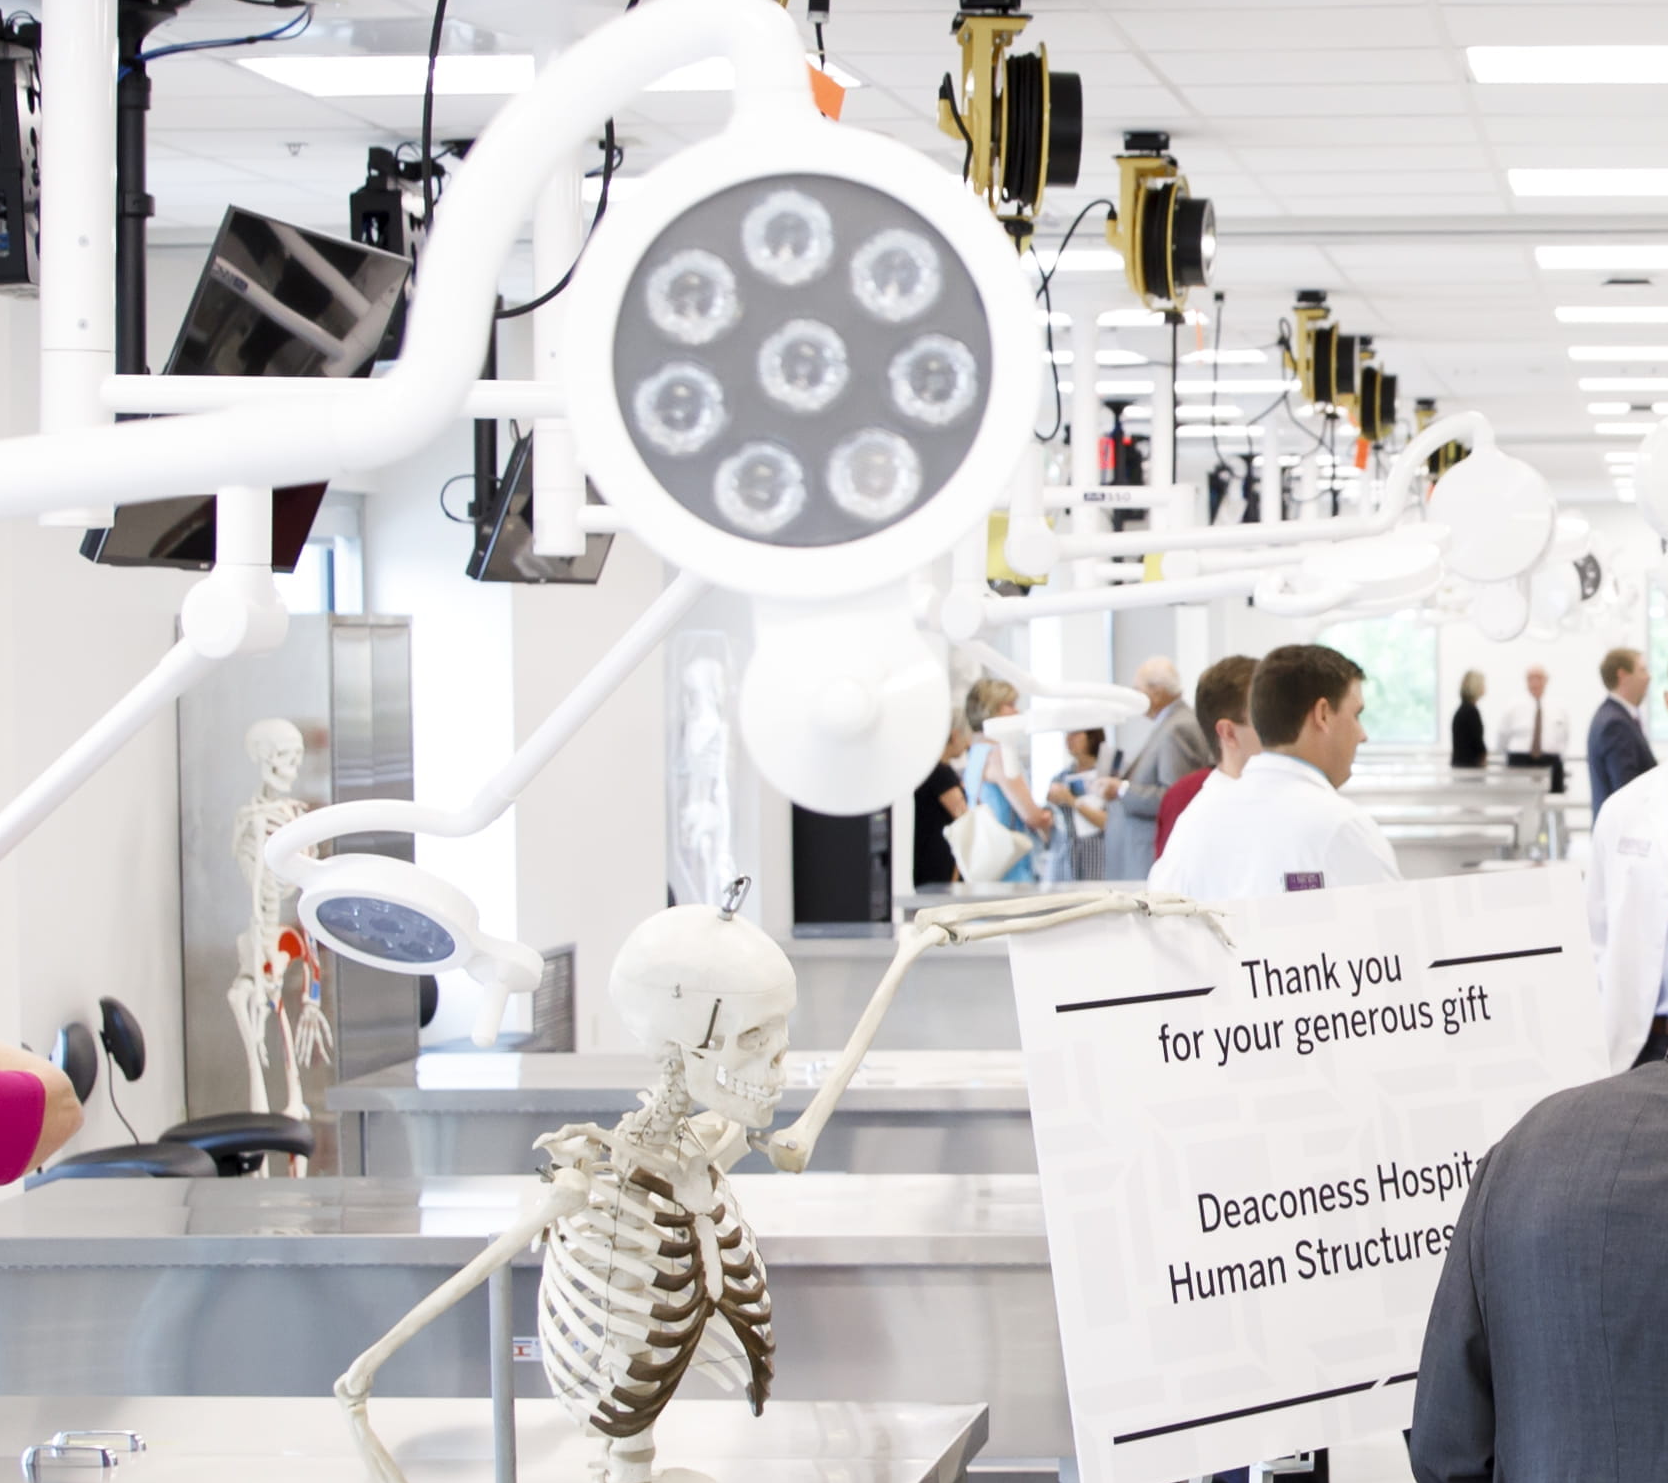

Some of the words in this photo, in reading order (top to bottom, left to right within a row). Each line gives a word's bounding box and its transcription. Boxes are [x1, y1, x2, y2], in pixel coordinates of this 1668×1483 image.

[1241, 952, 1341, 999] Thank
[1347, 954, 1402, 997] you
[1158, 1023, 1204, 1063] for
[1213, 1019, 1284, 1067] your
[1294, 1001, 1434, 1056] generous
[1441, 985, 1491, 1036] gift
[1197, 1178, 1370, 1233] Deaconess
[1376, 1150, 1482, 1202] Hospit
[1168, 1255, 1287, 1305] Human
